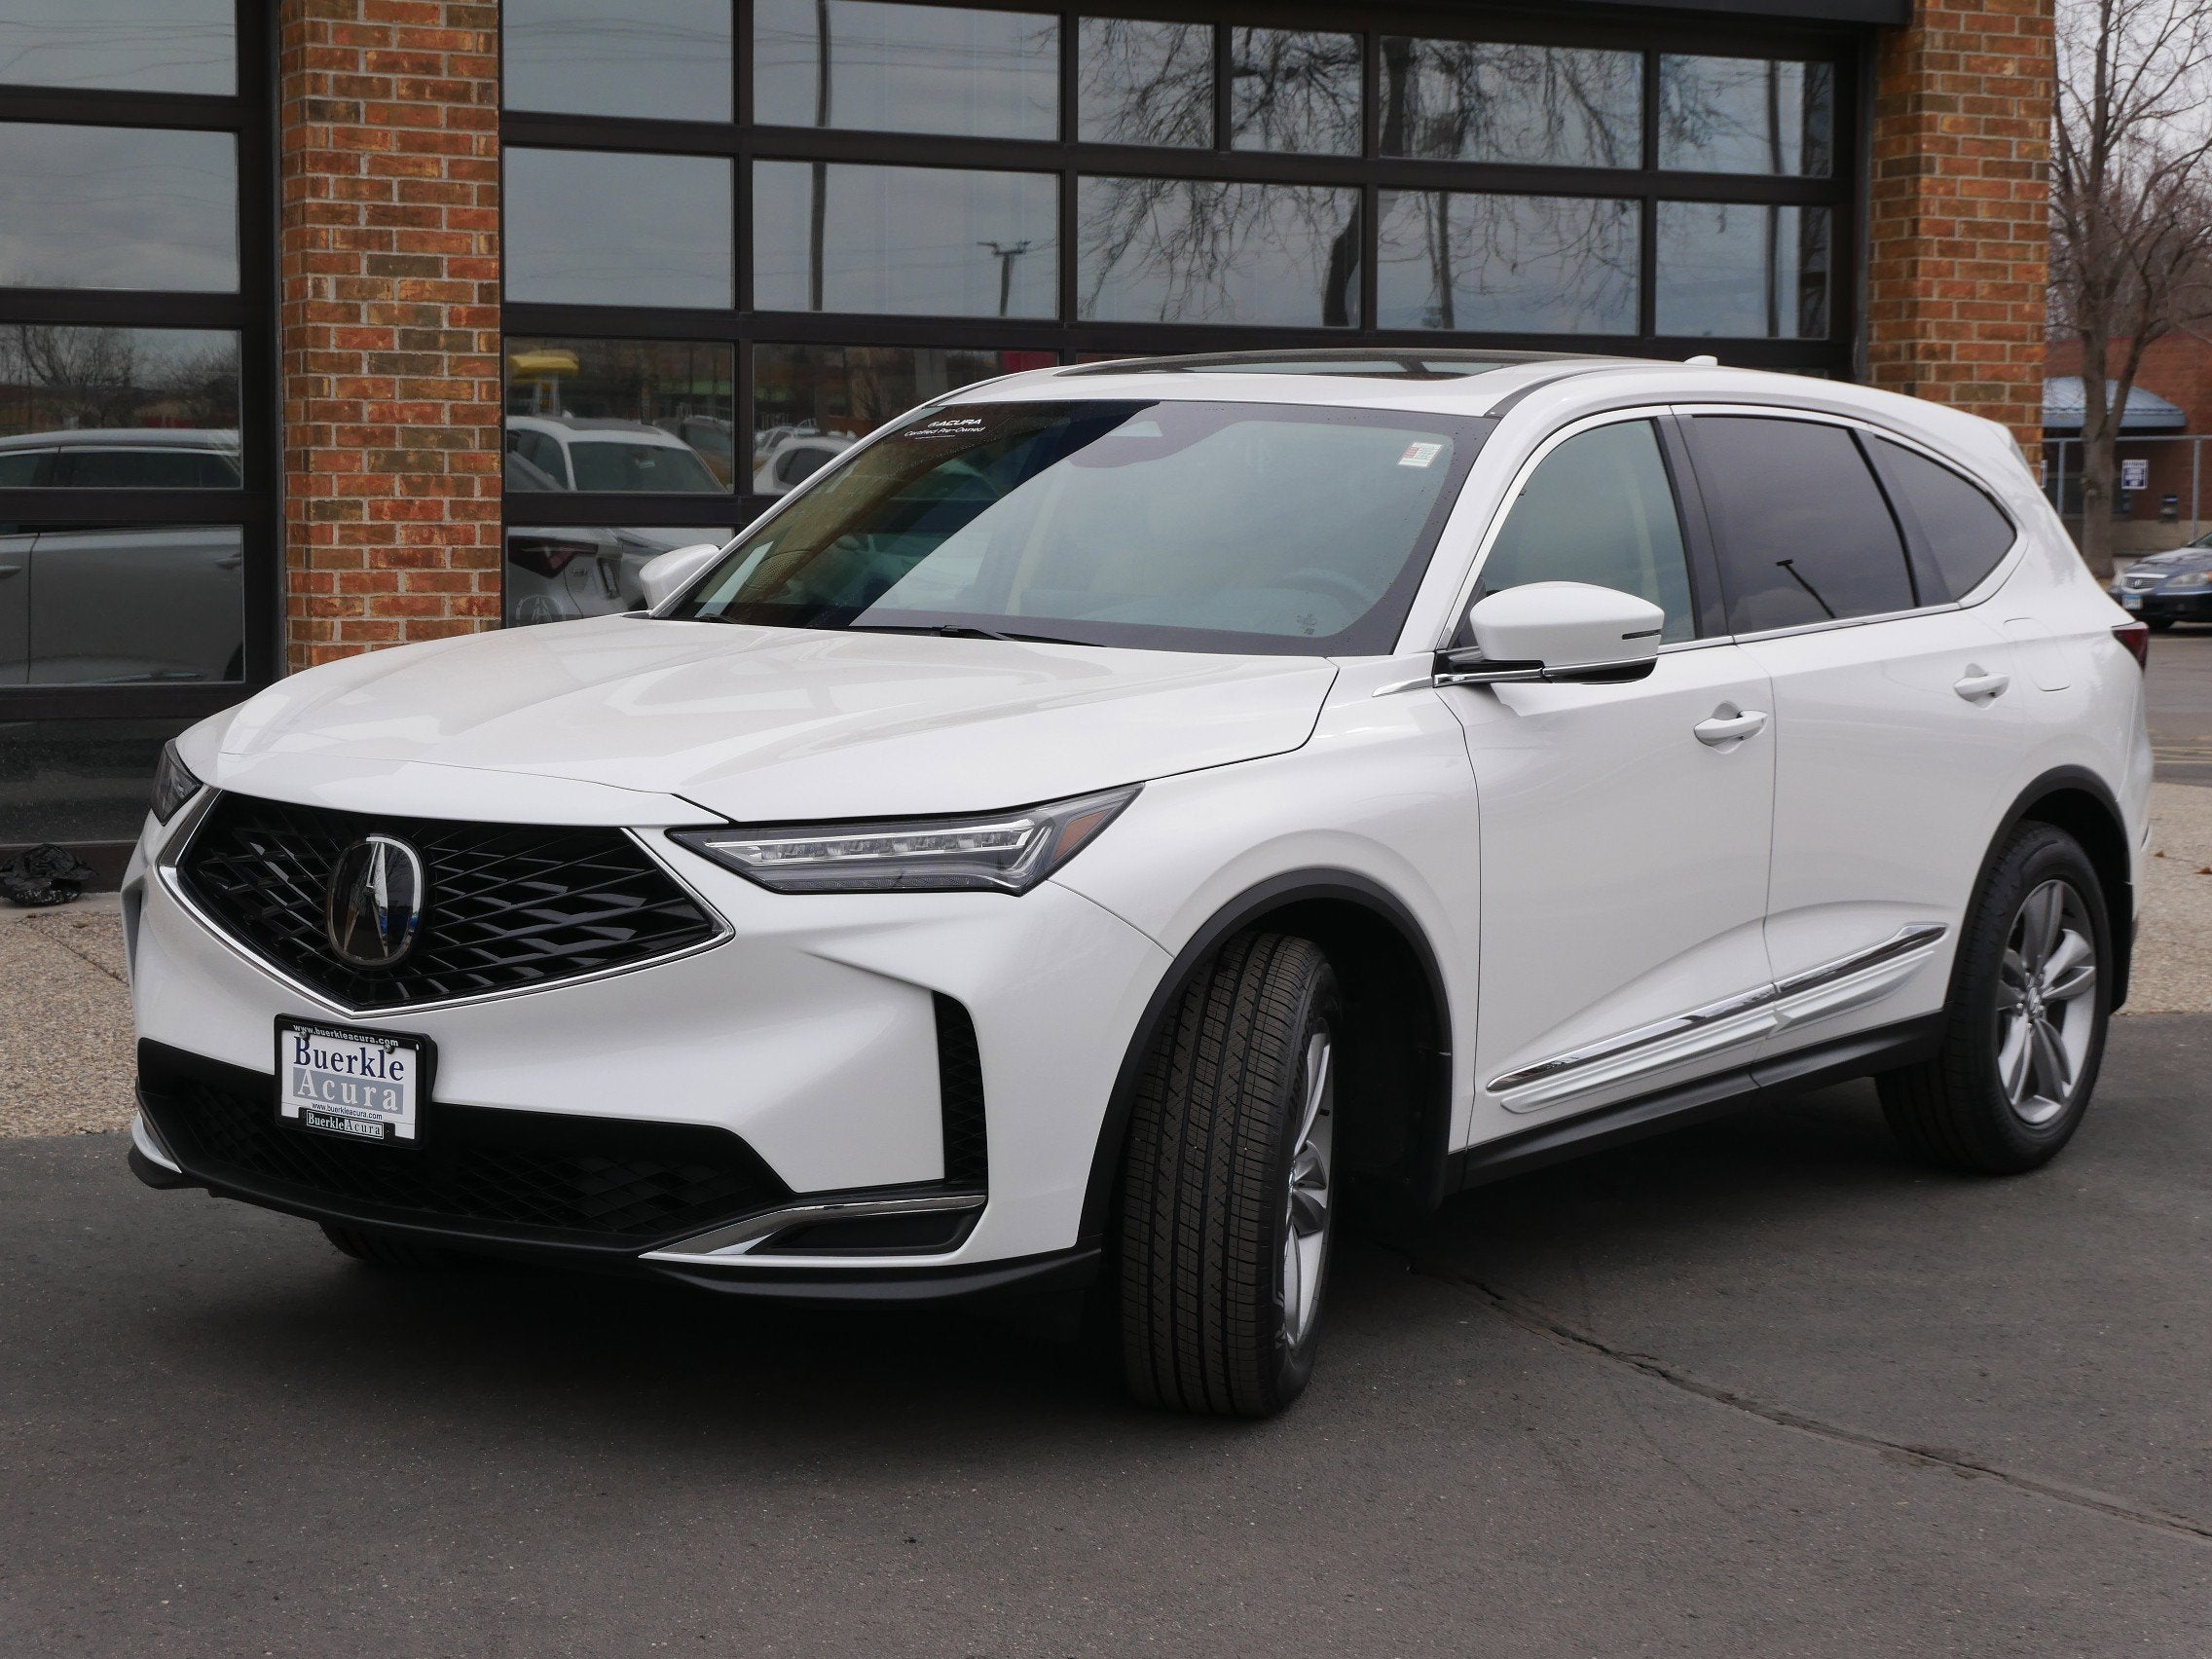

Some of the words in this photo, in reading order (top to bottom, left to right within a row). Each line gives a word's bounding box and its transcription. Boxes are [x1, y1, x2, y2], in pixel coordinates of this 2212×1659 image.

[903, 428, 939, 437] Certified
[938, 419, 982, 427] ACURA
[293, 1024, 399, 1047] www.buerkleacura.com
[294, 1035, 404, 1081] Buerkle
[297, 1069, 398, 1111] Acura
[312, 1102, 383, 1121] www.buerkleacura.com
